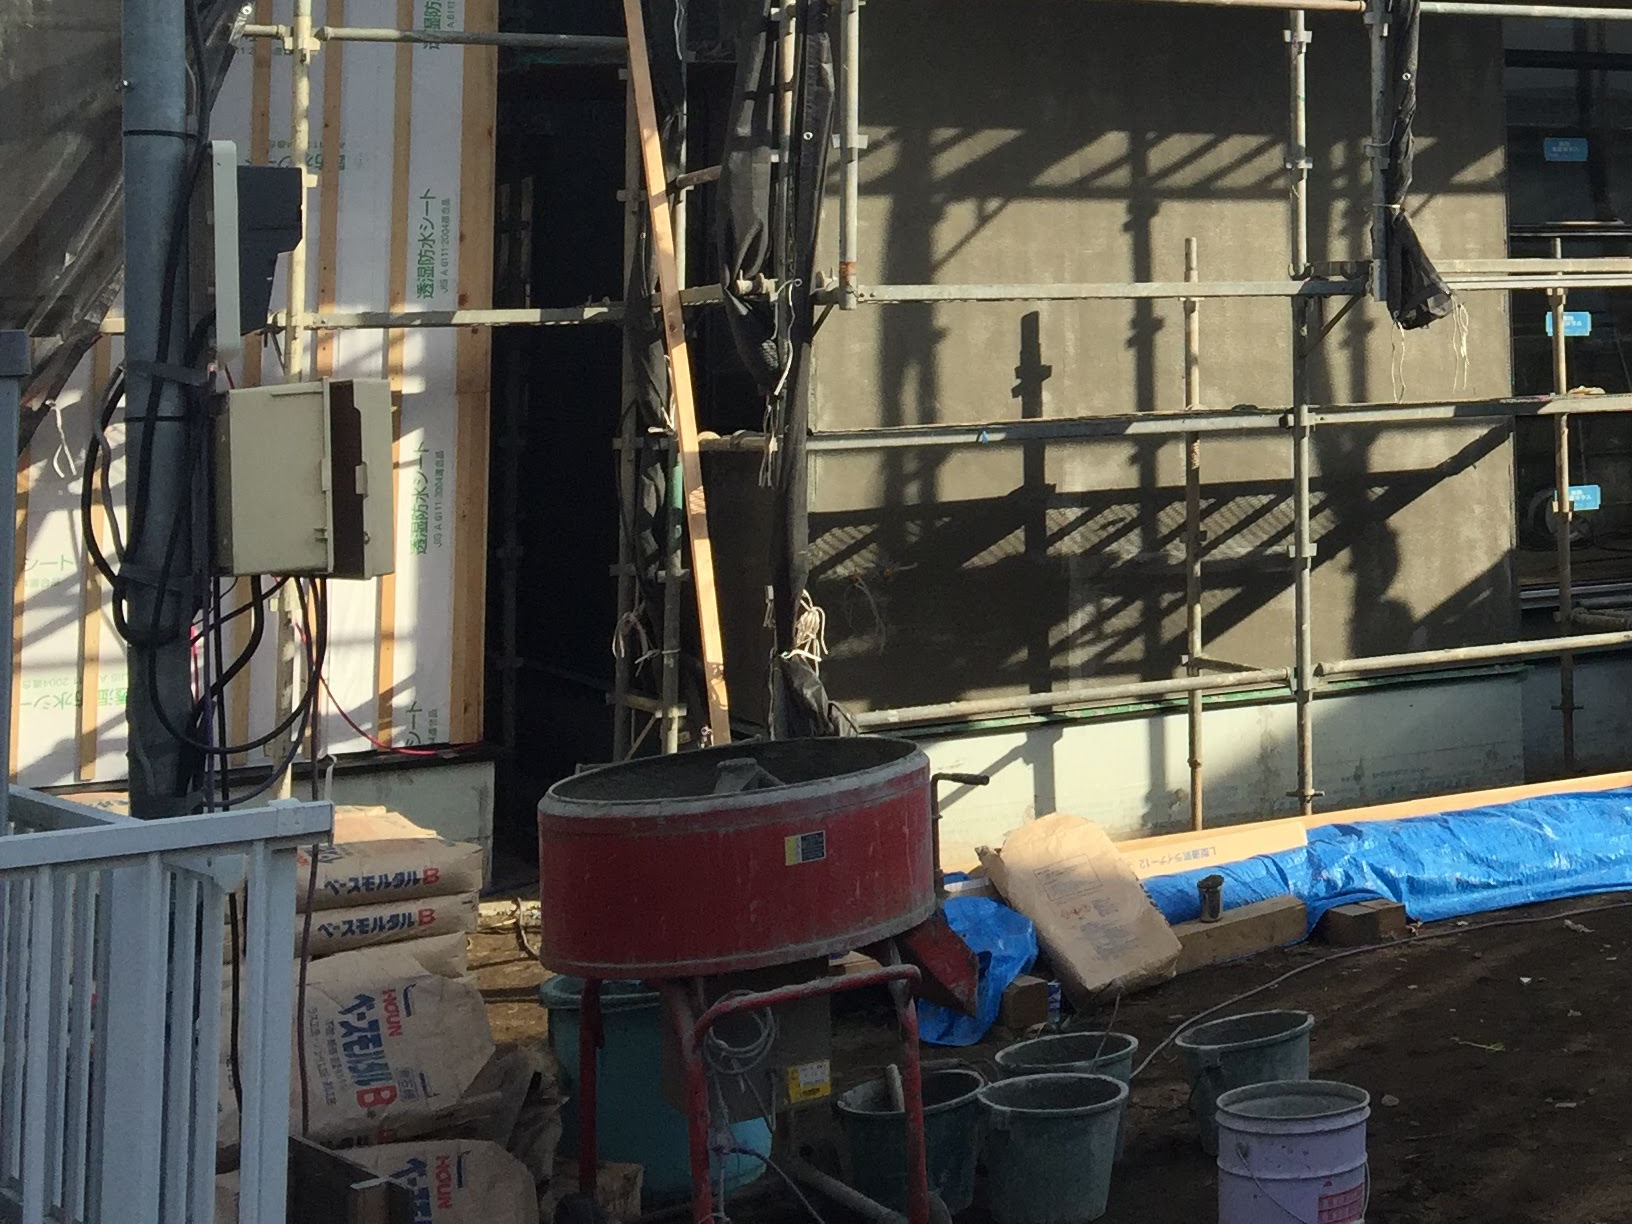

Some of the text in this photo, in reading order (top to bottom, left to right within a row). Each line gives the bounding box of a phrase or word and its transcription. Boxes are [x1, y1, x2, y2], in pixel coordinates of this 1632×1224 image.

[416, 187, 436, 299] 透湿防水シート
[382, 988, 403, 1037] HOUN
[435, 1155, 453, 1209] HOUN
